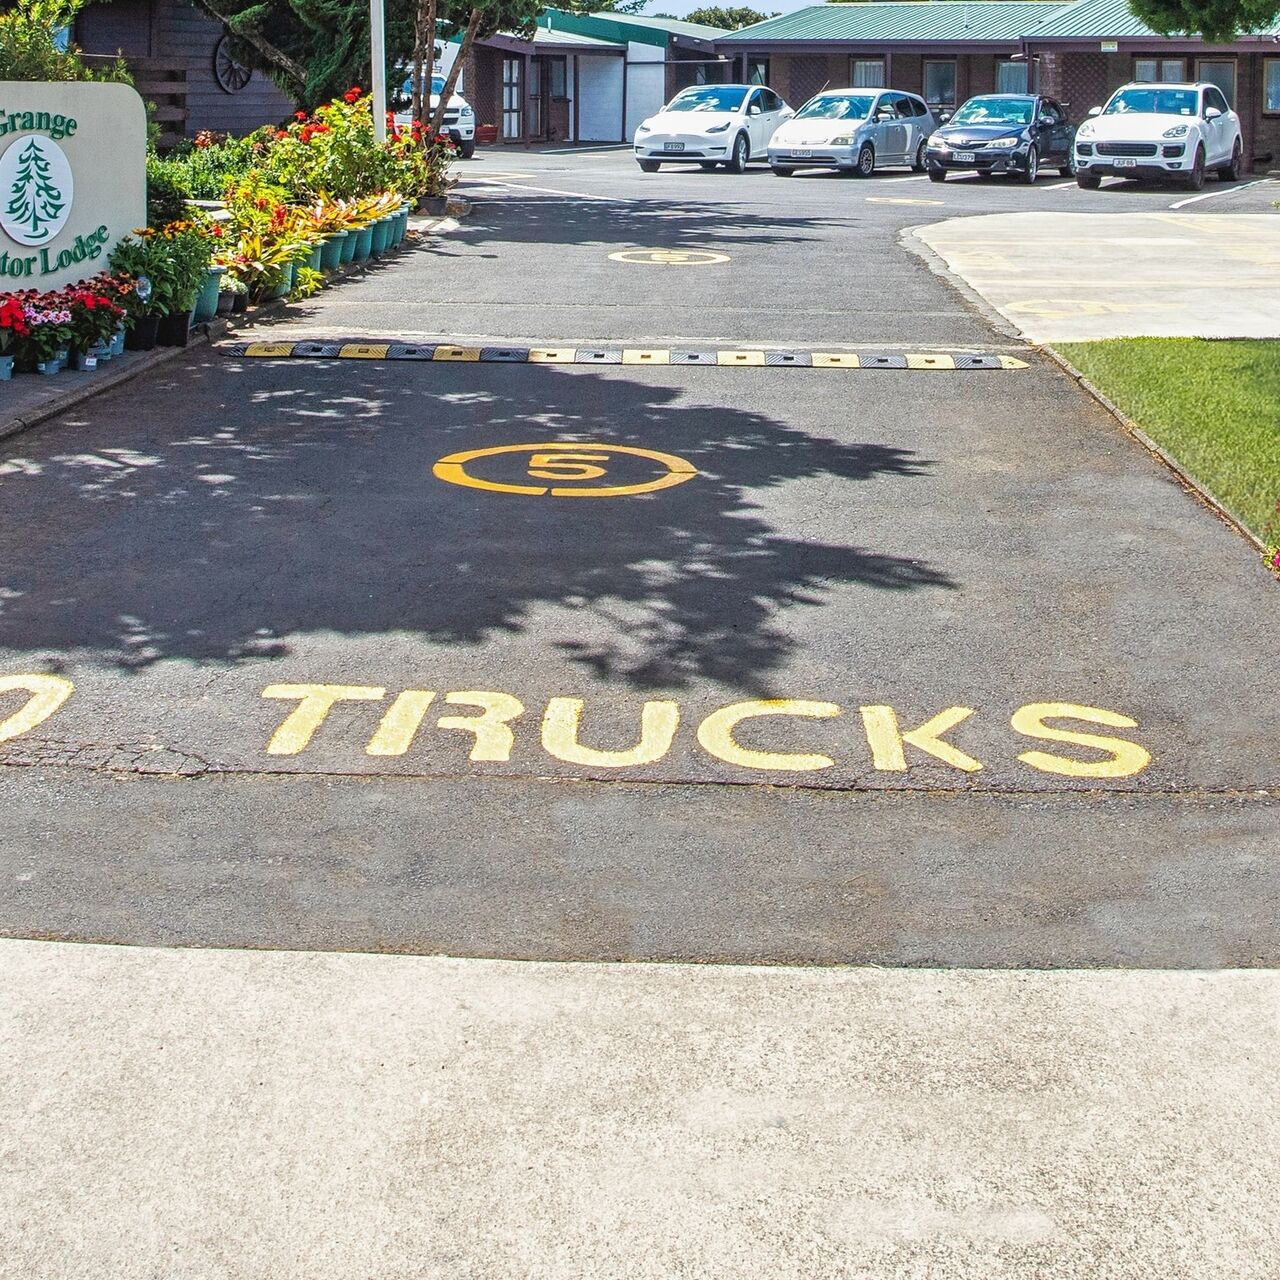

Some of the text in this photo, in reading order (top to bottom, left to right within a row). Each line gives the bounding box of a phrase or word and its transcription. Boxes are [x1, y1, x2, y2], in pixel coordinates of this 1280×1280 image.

[39, 224, 110, 276] Lodge
[528, 454, 609, 480] 5
[261, 683, 1151, 777] TRUCKS
